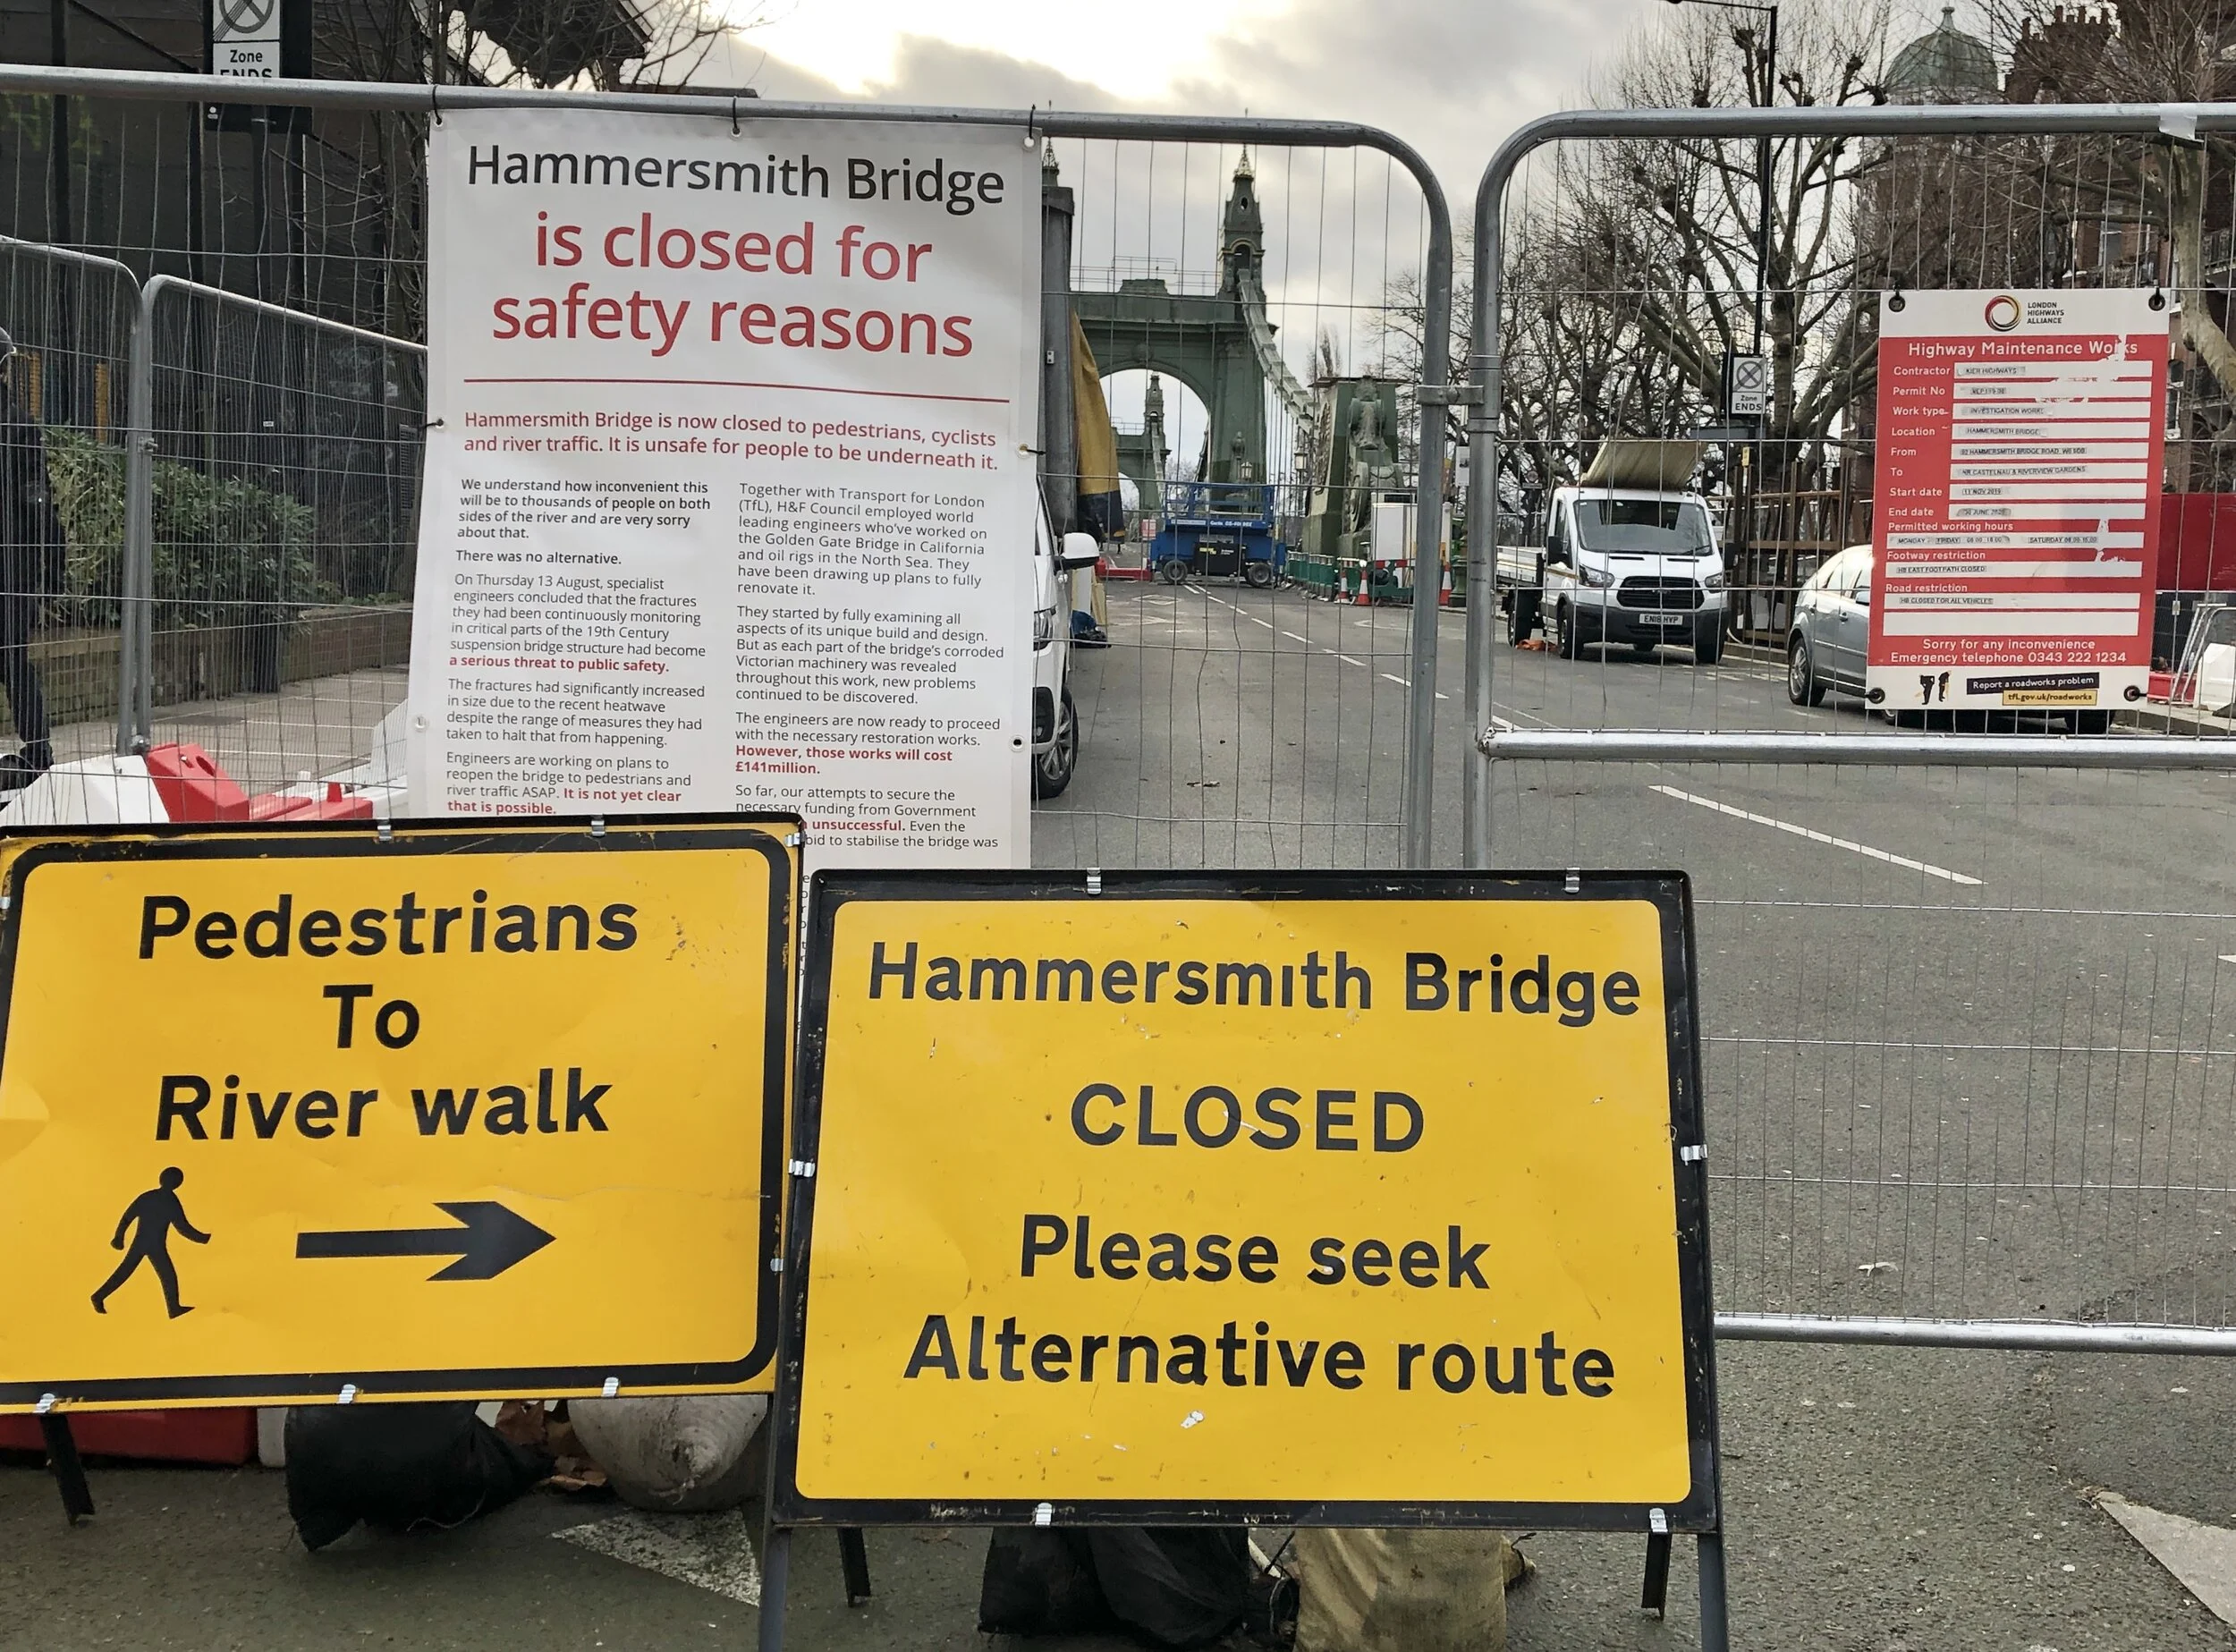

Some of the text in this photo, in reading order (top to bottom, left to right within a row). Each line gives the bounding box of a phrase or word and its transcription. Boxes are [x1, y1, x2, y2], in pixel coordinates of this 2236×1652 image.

[230, 49, 263, 64] Zone
[469, 145, 1004, 216] Hammersmith Bridge
[538, 211, 933, 282] is closed for
[494, 283, 972, 358] safety reasons
[1909, 343, 1975, 358] Highway
[1982, 342, 2082, 355] Maintenance
[1893, 367, 1950, 376] Contractor
[1893, 386, 1945, 395] Permit No
[1735, 402, 1762, 411] ENDS
[1893, 406, 1945, 417] Work type
[466, 412, 996, 448] Hammersmith Bridge is now closed to pedestrians, cyclists
[1892, 427, 1935, 436] Location
[464, 436, 997, 470] and river traffic. It is unsafe for people to be underneath it.
[1891, 447, 1917, 456] From
[1890, 468, 1902, 476] To
[462, 479, 708, 493] We understand how inconvenient this
[1890, 487, 1942, 496] Start date
[740, 483, 984, 507] Together with Transport for London
[739, 499, 973, 523] (TfL), H&F Council employed world
[1889, 507, 1934, 516] End date
[1888, 521, 2013, 532] Permitted working hours
[456, 550, 622, 564] There was no alternative.
[1887, 551, 1986, 561] Footway restriction
[455, 573, 665, 590] On Thursday 13 August, specialist
[1885, 583, 1968, 592] Road restriction
[453, 592, 697, 607] engineers concluded that the fractures
[1923, 639, 2096, 651] Sorry for any inconvenience
[450, 656, 669, 674] a serious threat to public safety.
[736, 656, 956, 673] Victorian machinery was revealed
[1891, 652, 2126, 665] Emergency telephone 0343 222 1234
[1973, 682, 2003, 690] Report
[2012, 678, 2055, 687] roadworks
[2058, 676, 2094, 687] problem
[736, 745, 953, 761] However, those works will cost
[735, 761, 820, 774] £141million.
[805, 804, 855, 815] funding
[859, 804, 890, 815] from
[894, 804, 976, 817] Government
[812, 819, 905, 831] unsuccessful.
[910, 820, 940, 832] Even
[944, 821, 965, 832] the
[139, 889, 638, 960] Pedestrians
[1406, 953, 1640, 1028] Bridge
[323, 984, 419, 1049] To
[156, 1067, 613, 1140] River walk
[1071, 1083, 1424, 1153] CLOSED
[1021, 1214, 1491, 1289] Please seek
[903, 1315, 1614, 1398] Alternative route
